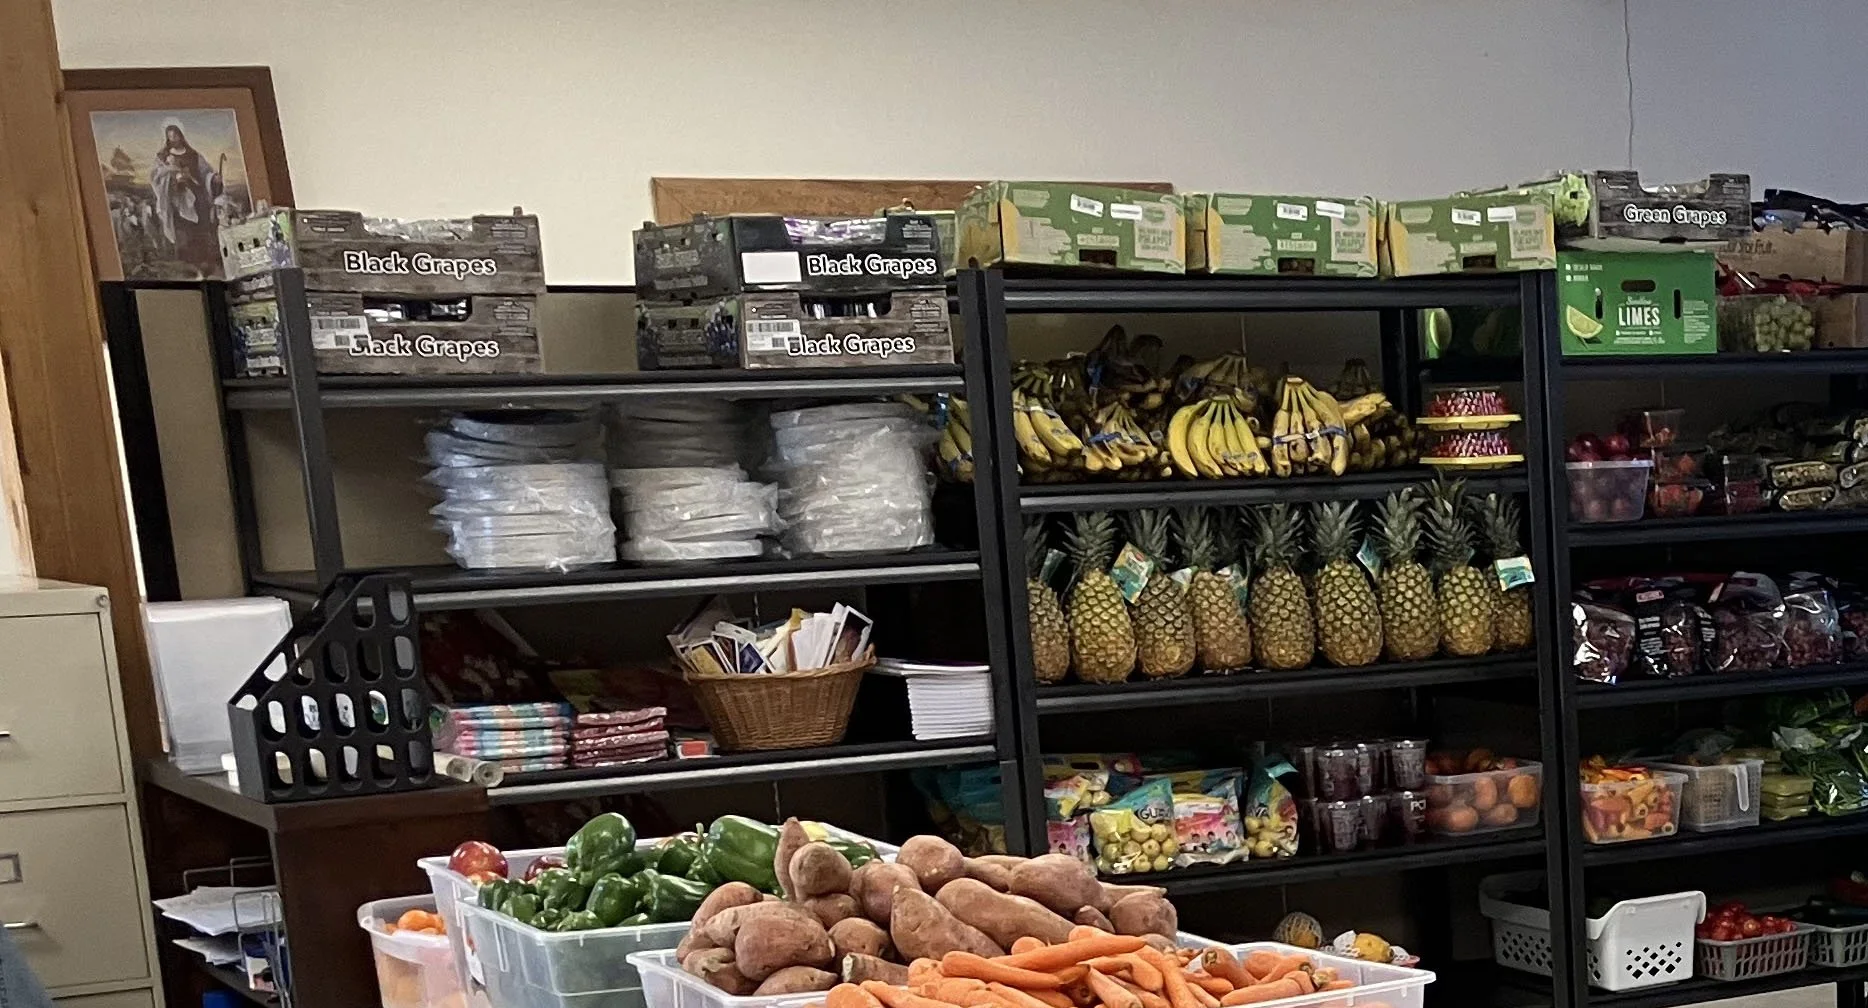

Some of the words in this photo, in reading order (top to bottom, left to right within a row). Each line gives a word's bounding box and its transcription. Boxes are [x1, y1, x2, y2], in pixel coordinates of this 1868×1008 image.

[1623, 203, 1671, 224] Green
[1673, 204, 1727, 229] Grapes
[344, 251, 408, 275] Black
[412, 252, 498, 281] Grapes
[807, 254, 863, 276] Black
[865, 254, 937, 279] Grapes
[1618, 306, 1661, 326] LIMES
[415, 336, 499, 364] Grapes
[842, 335, 916, 359] Grapes
